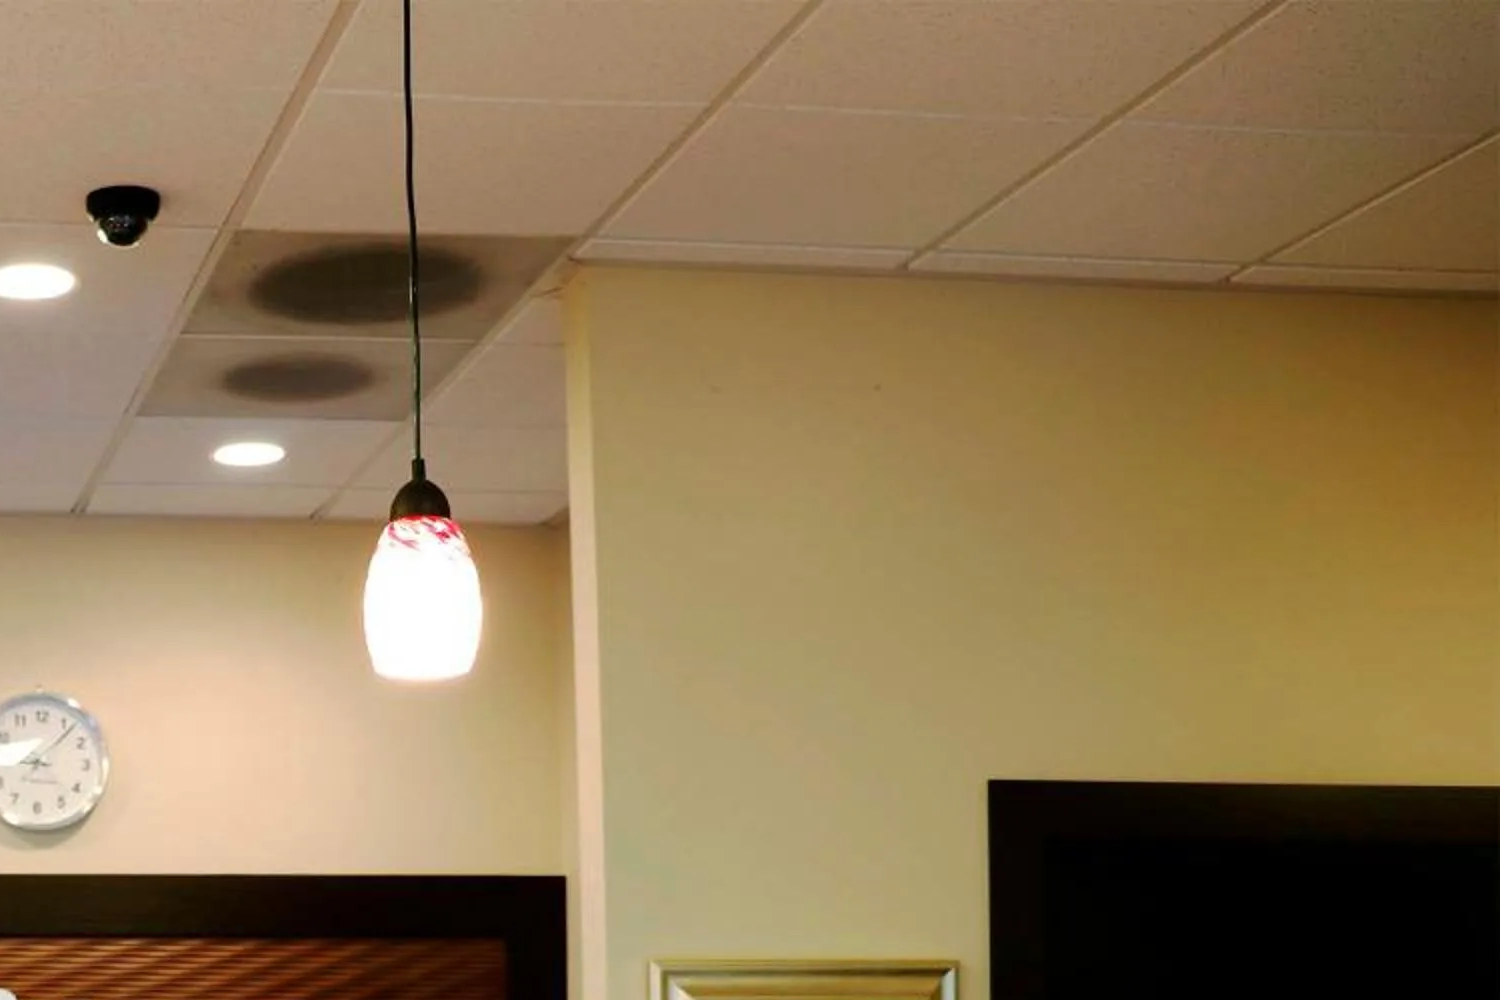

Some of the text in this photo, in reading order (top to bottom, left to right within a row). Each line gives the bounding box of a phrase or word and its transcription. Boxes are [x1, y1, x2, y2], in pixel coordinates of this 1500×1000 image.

[14, 714, 27, 727] 11
[35, 711, 49, 723] 12
[76, 737, 85, 749] 2
[81, 759, 91, 772] 3
[71, 782, 81, 793] 4
[10, 793, 19, 804] 7
[57, 795, 66, 809] 5
[32, 801, 42, 815] 6
